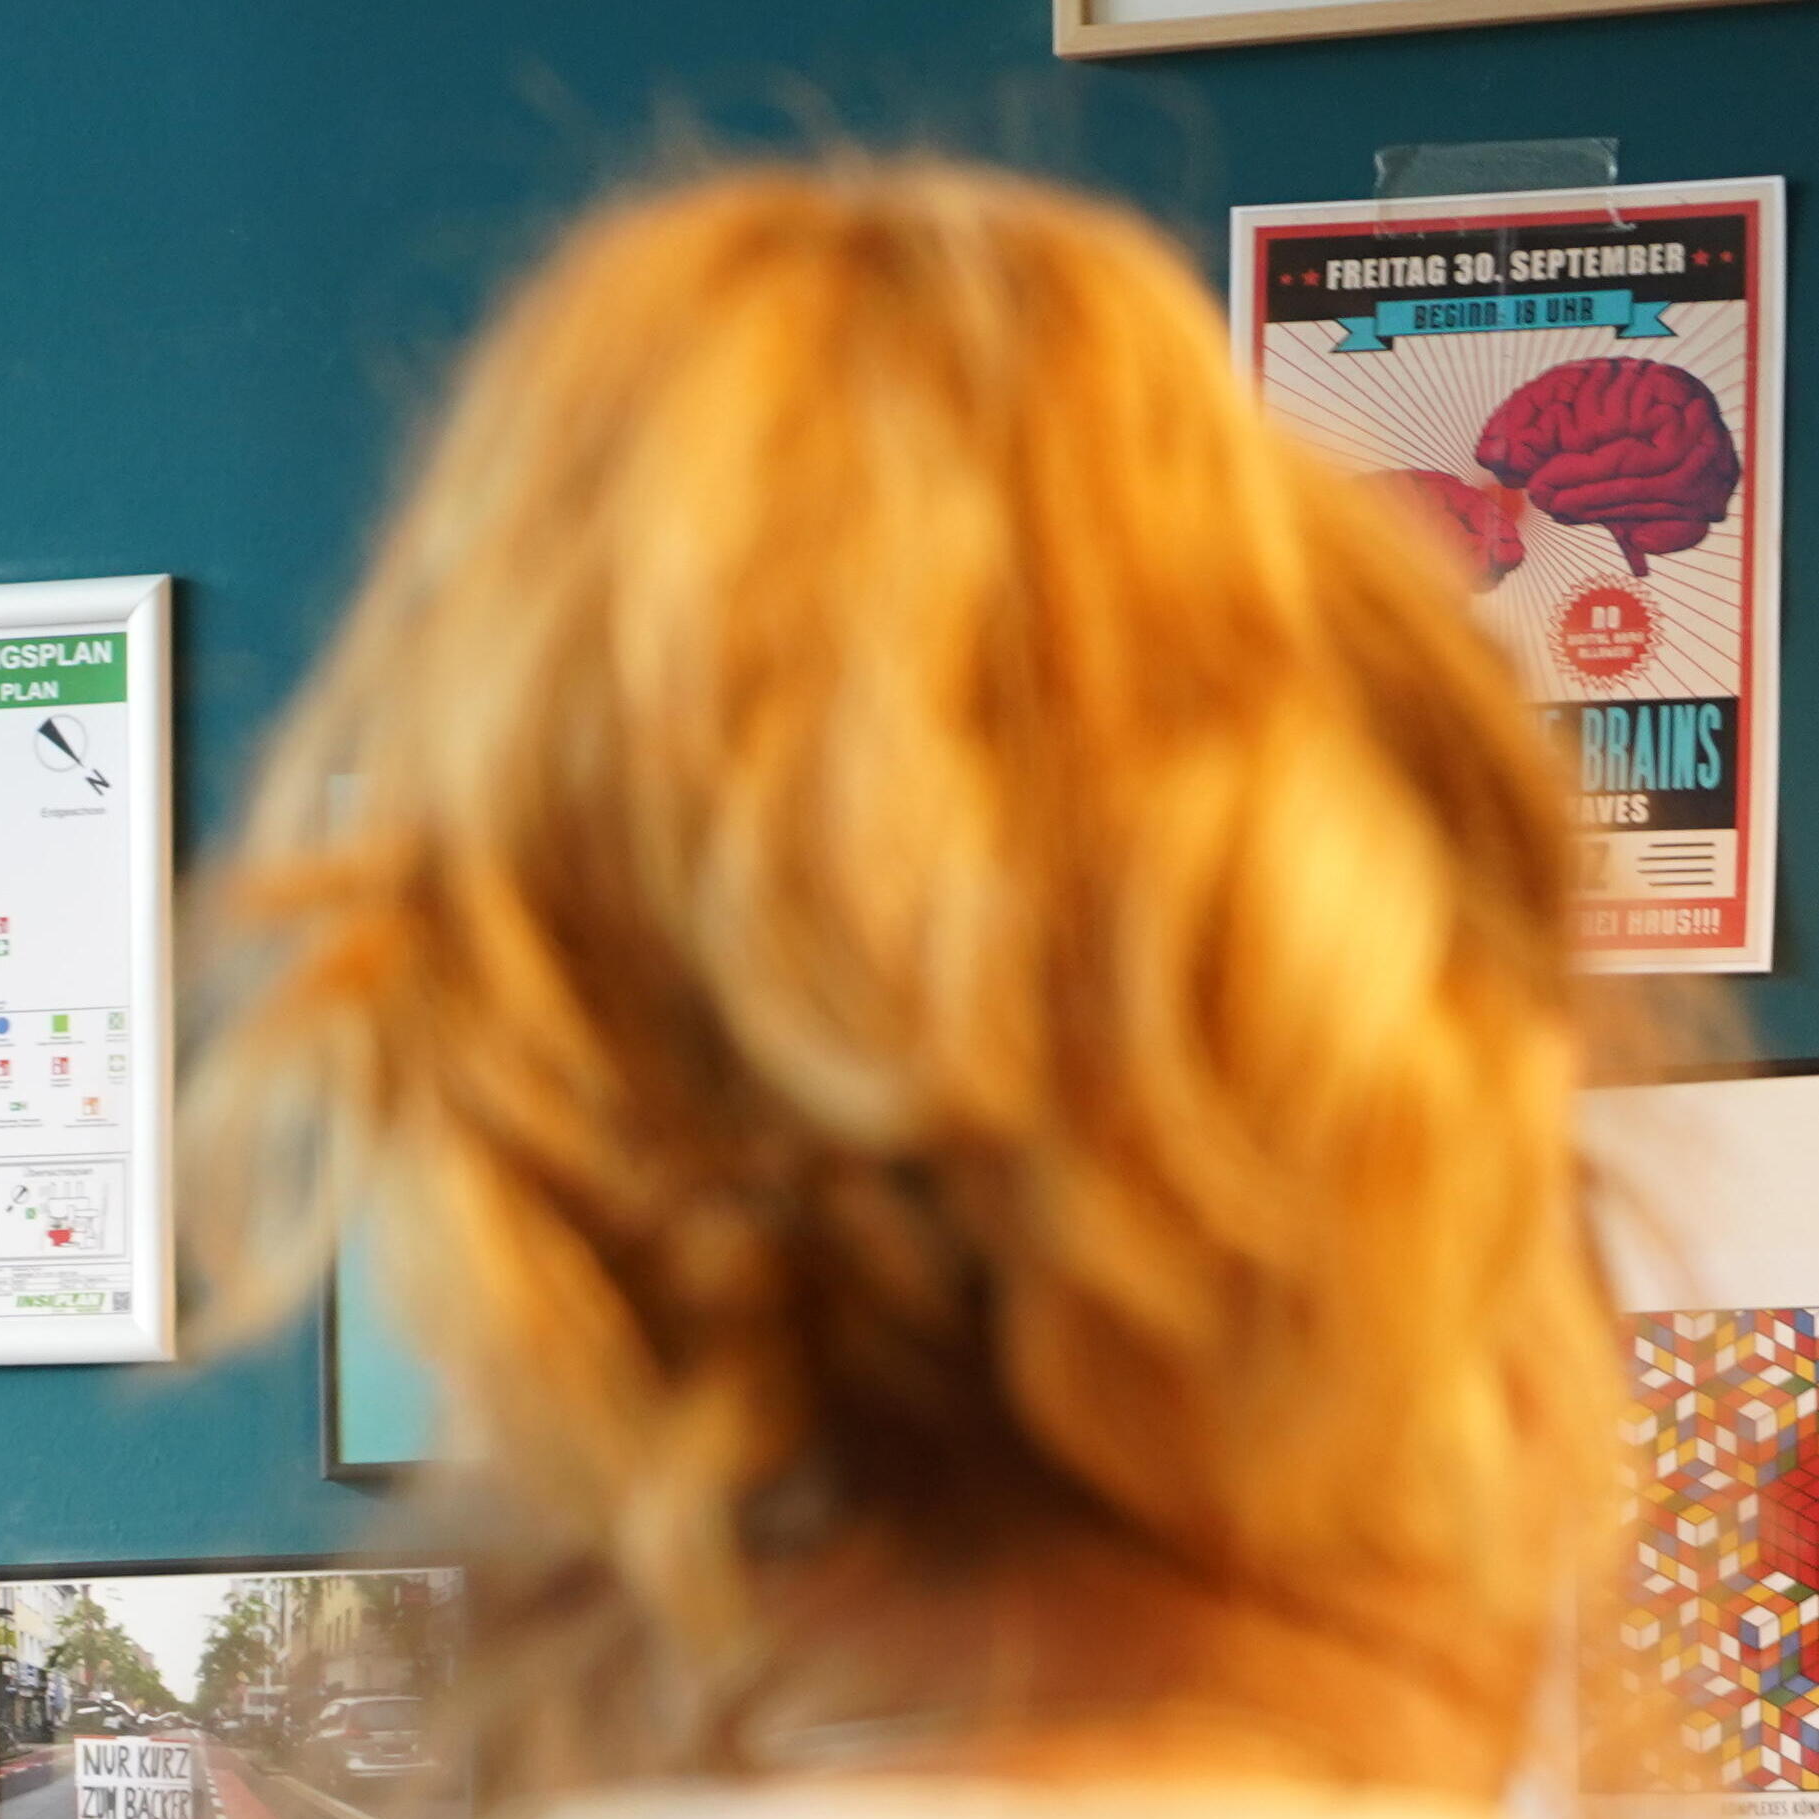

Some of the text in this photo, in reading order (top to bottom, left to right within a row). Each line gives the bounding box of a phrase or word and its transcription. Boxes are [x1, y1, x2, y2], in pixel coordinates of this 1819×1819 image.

[1326, 242, 1686, 290] FREITAG 30. SEPTEMBER
[1546, 297, 1594, 323] UHR
[0, 680, 59, 702] PLAN
[1579, 702, 1724, 793] BRAINS
[84, 768, 111, 796] N
[1572, 794, 1650, 824] AVES
[83, 1745, 190, 1779] NUR KURZ
[82, 1785, 118, 1819] ZUM
